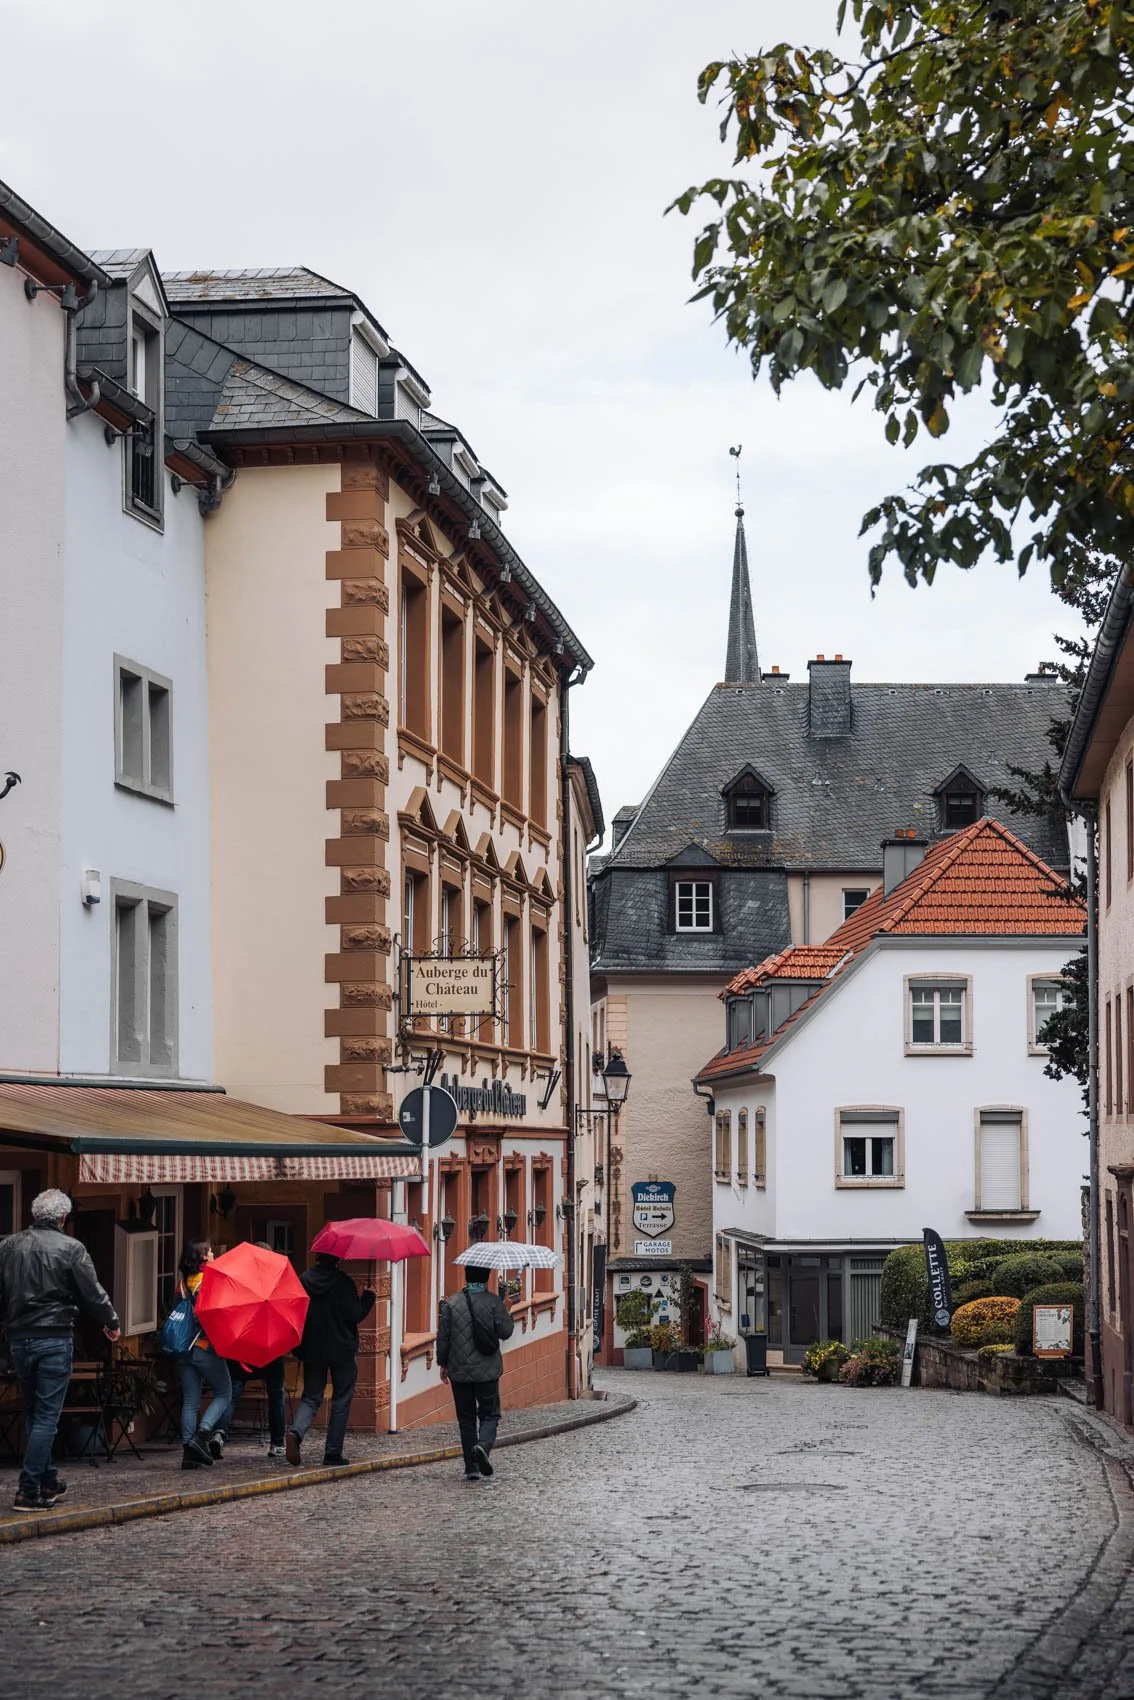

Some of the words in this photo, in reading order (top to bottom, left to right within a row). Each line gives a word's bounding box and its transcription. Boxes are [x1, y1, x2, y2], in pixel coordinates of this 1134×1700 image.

[416, 966, 468, 980] Auberge
[472, 965, 488, 978] du
[425, 982, 478, 995] Château
[415, 1000, 438, 1008] Hôtel
[637, 1192, 669, 1202] Diekirch
[928, 1244, 943, 1309] COLLETTE
